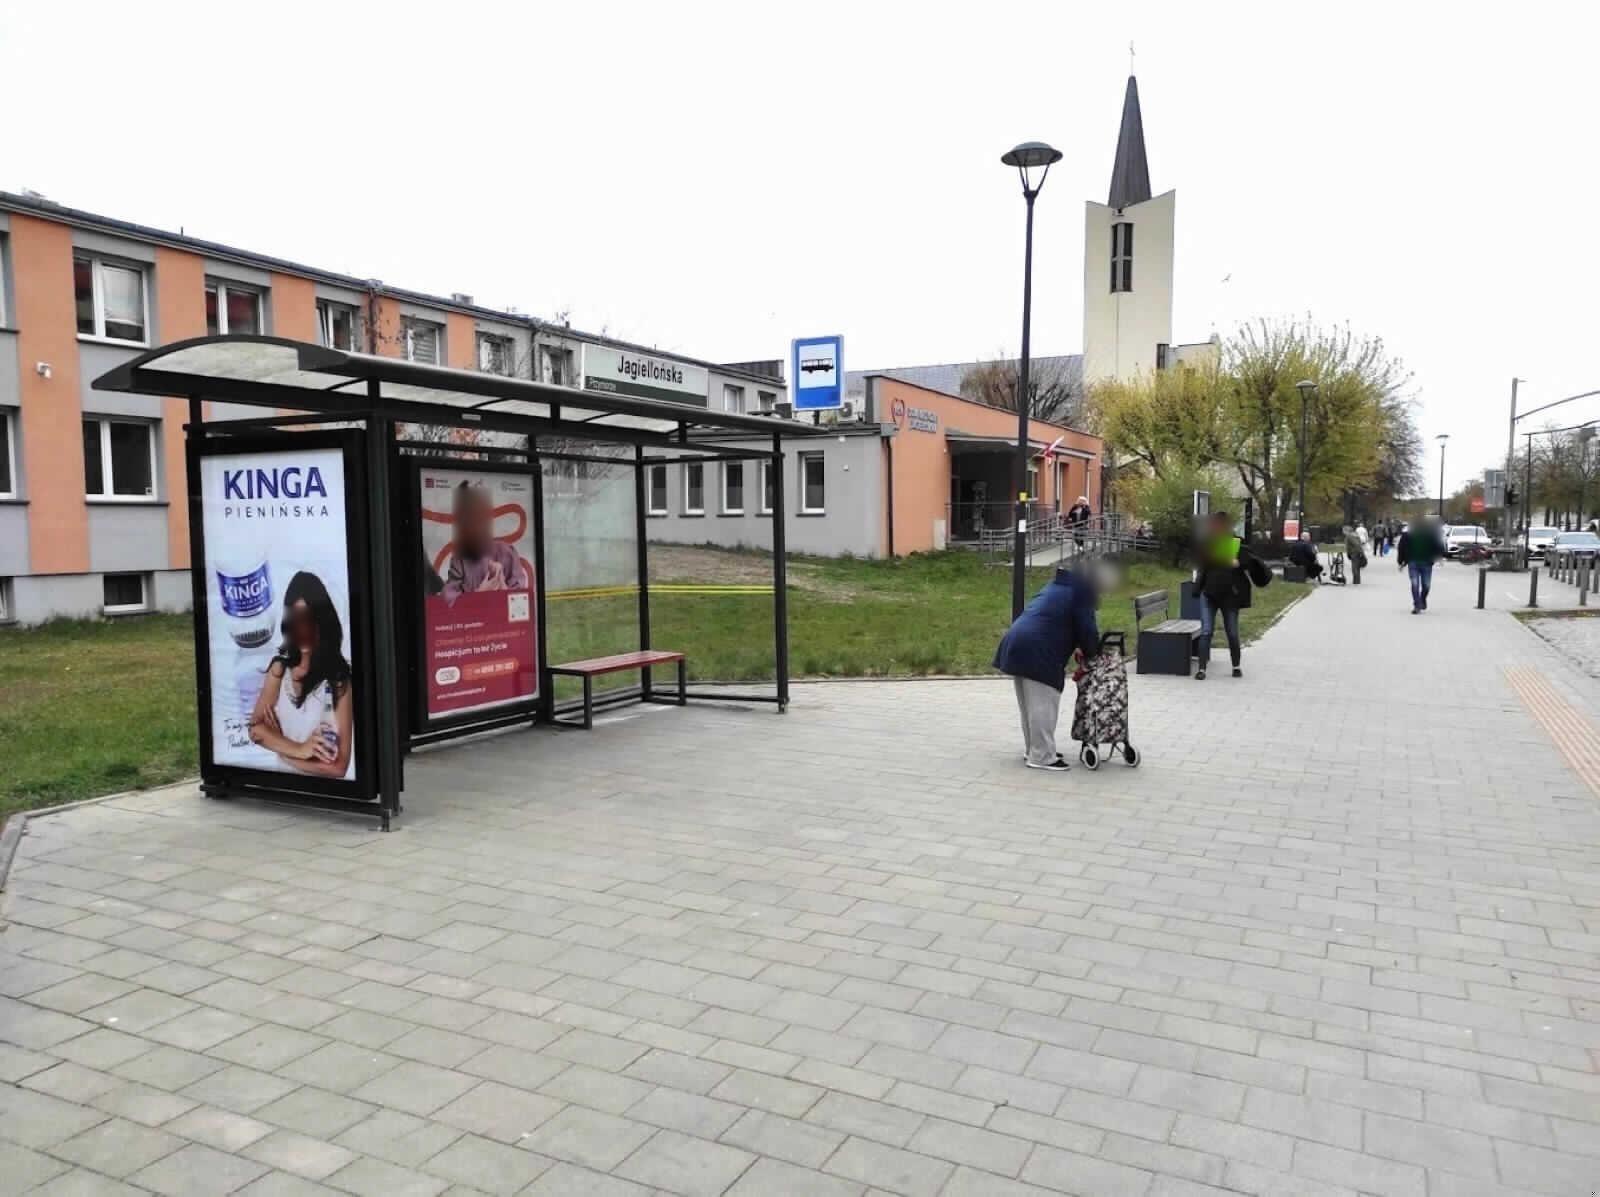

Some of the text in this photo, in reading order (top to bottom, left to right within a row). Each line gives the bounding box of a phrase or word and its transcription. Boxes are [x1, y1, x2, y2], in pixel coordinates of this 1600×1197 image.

[617, 355, 683, 384] Jagiellońska
[223, 466, 328, 500] KINGA
[225, 502, 329, 519] PIENIŃSKA
[223, 576, 269, 600] KINGA
